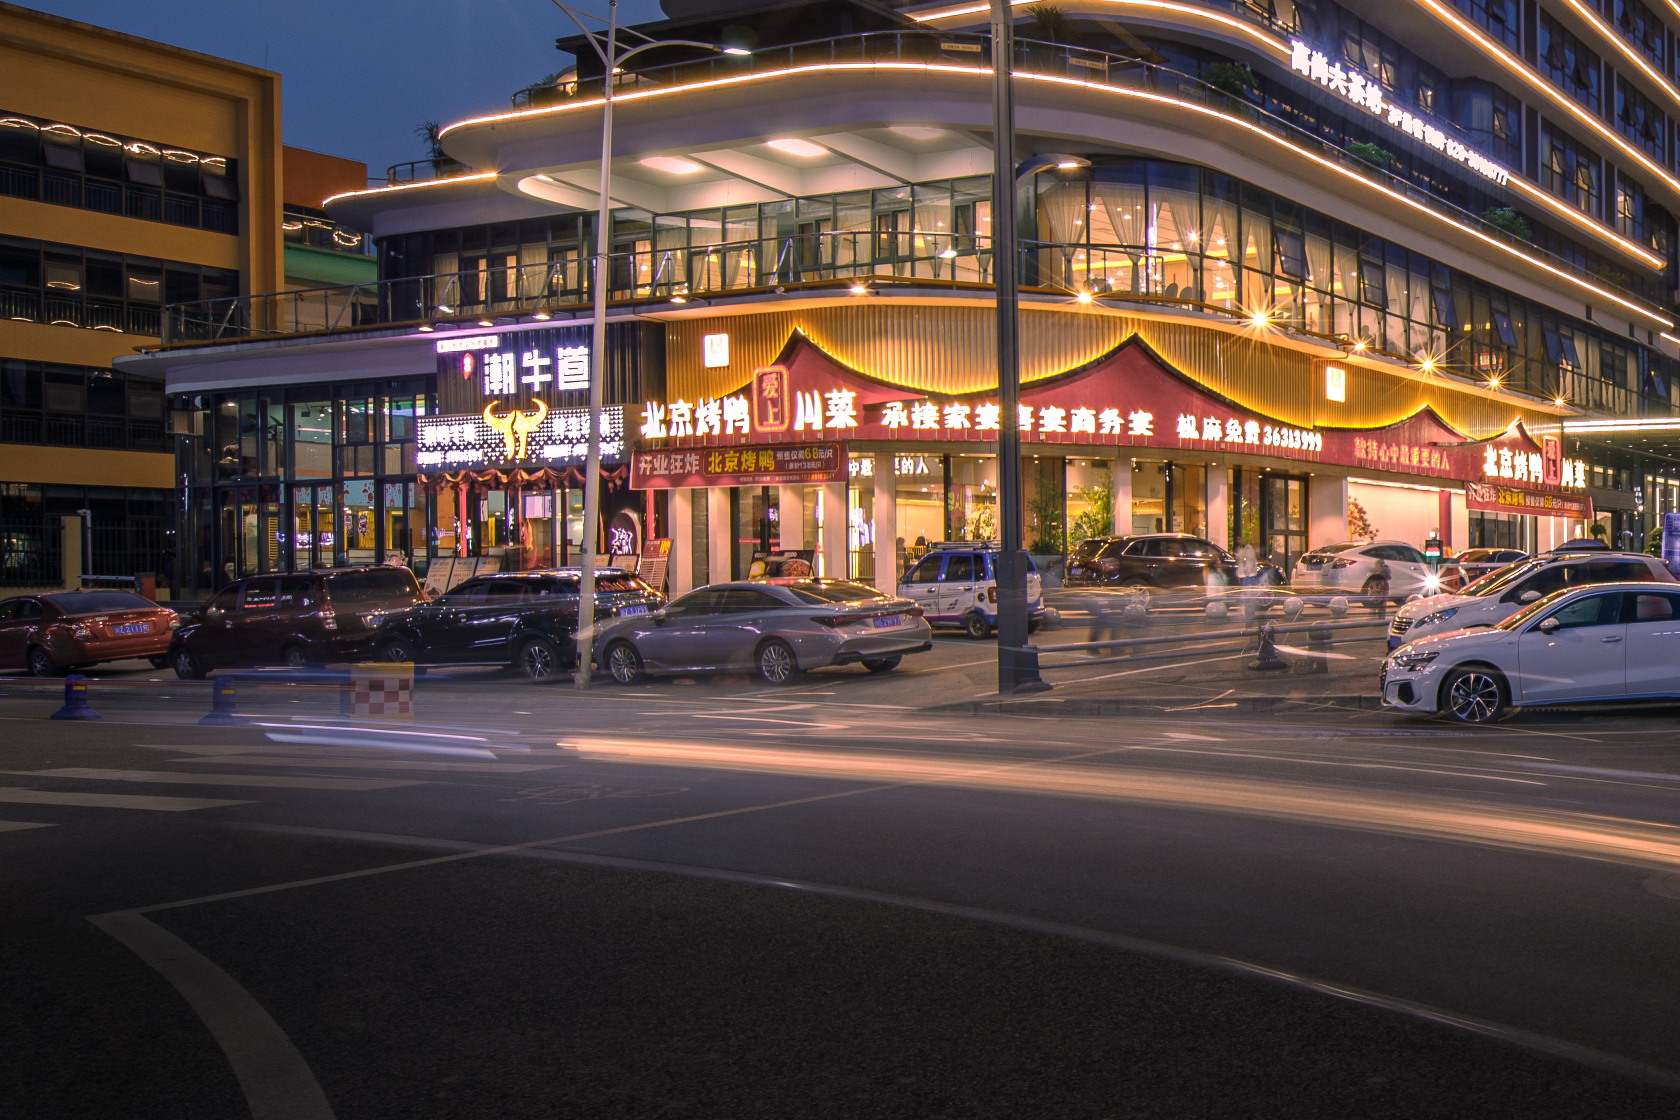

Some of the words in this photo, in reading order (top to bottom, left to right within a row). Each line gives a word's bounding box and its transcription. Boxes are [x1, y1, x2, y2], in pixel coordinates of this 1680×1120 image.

[639, 394, 750, 439] 北京烤鸭
[762, 372, 779, 426] 爱上
[794, 388, 858, 431] 川菜
[638, 453, 700, 476] 开业狂炸
[707, 448, 776, 474] 北京烤鸭
[1483, 443, 1544, 484] 北京烤鸭
